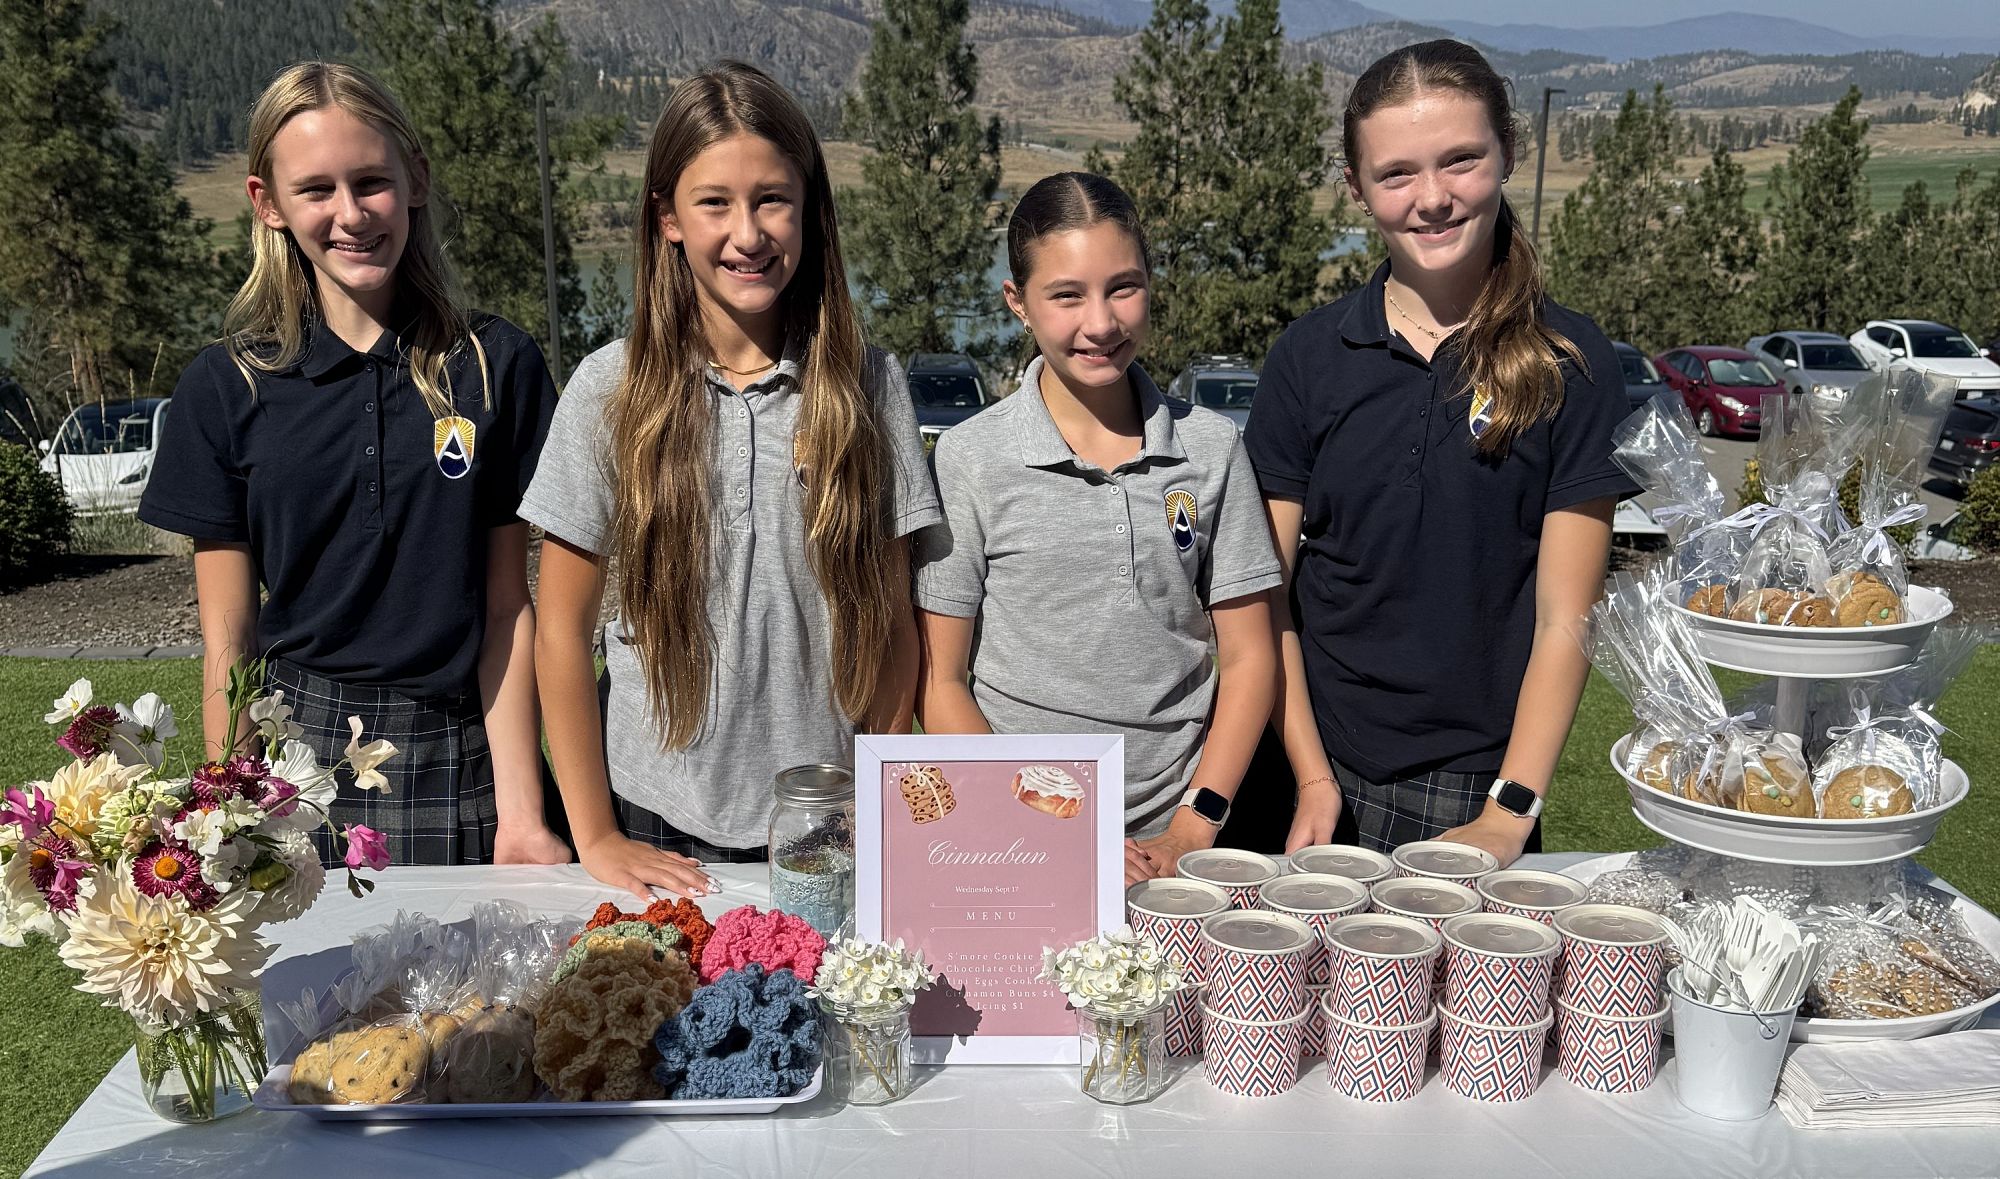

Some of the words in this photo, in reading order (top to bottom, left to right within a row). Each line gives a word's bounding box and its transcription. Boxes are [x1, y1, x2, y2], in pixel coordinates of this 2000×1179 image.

[928, 837, 1050, 867] Cinnabun
[955, 885, 993, 895] Wednesday
[995, 885, 1010, 895] Sept
[966, 911, 1016, 921] MENU
[948, 952, 988, 961] S'more
[994, 952, 1034, 961] Cookie
[946, 965, 1004, 973] Chocolate
[1009, 965, 1035, 974] Chip
[975, 977, 999, 987] Eggs
[945, 990, 1003, 998] Cinnamon
[1009, 990, 1036, 998] Buns
[977, 1002, 1007, 1011] Icing
[1012, 1002, 1024, 1010] $1
